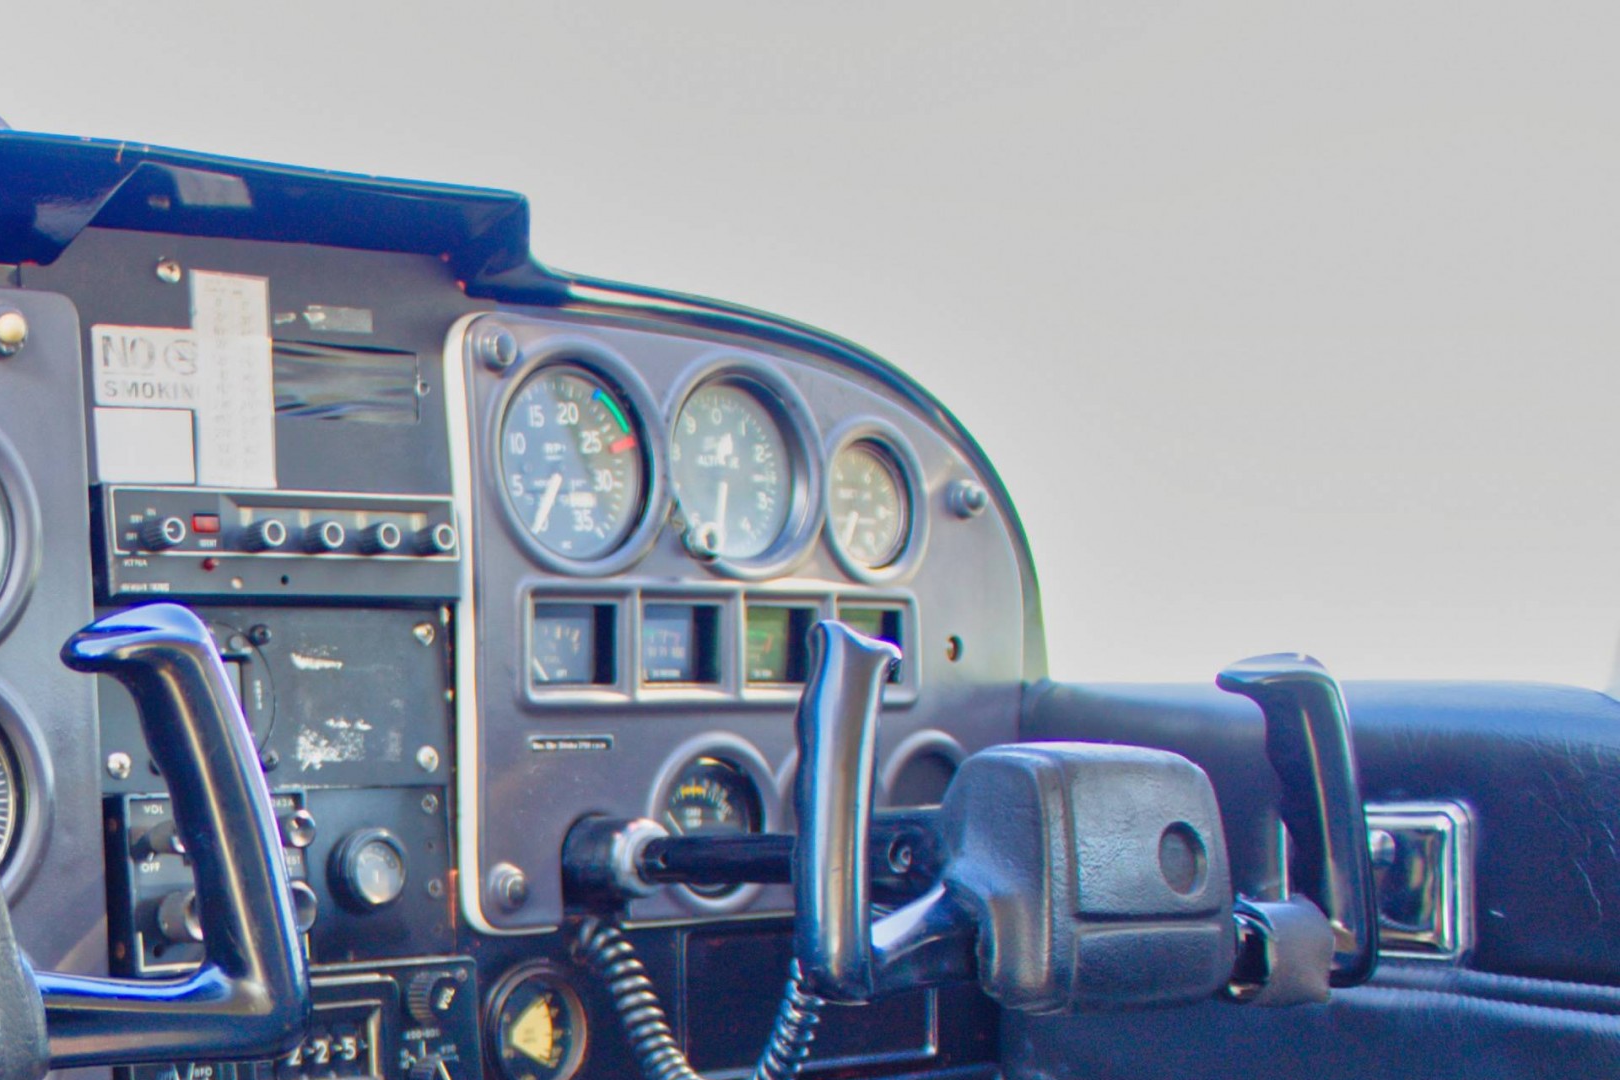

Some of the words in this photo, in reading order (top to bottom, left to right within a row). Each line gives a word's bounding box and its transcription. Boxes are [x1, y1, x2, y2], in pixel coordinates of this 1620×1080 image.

[102, 336, 155, 368] NO
[105, 380, 200, 399] SMOKIN
[529, 405, 544, 427] 15
[557, 402, 579, 425] 20
[511, 433, 526, 454] 10
[581, 431, 602, 453] 25
[595, 470, 613, 491] 30
[574, 511, 594, 531] 35
